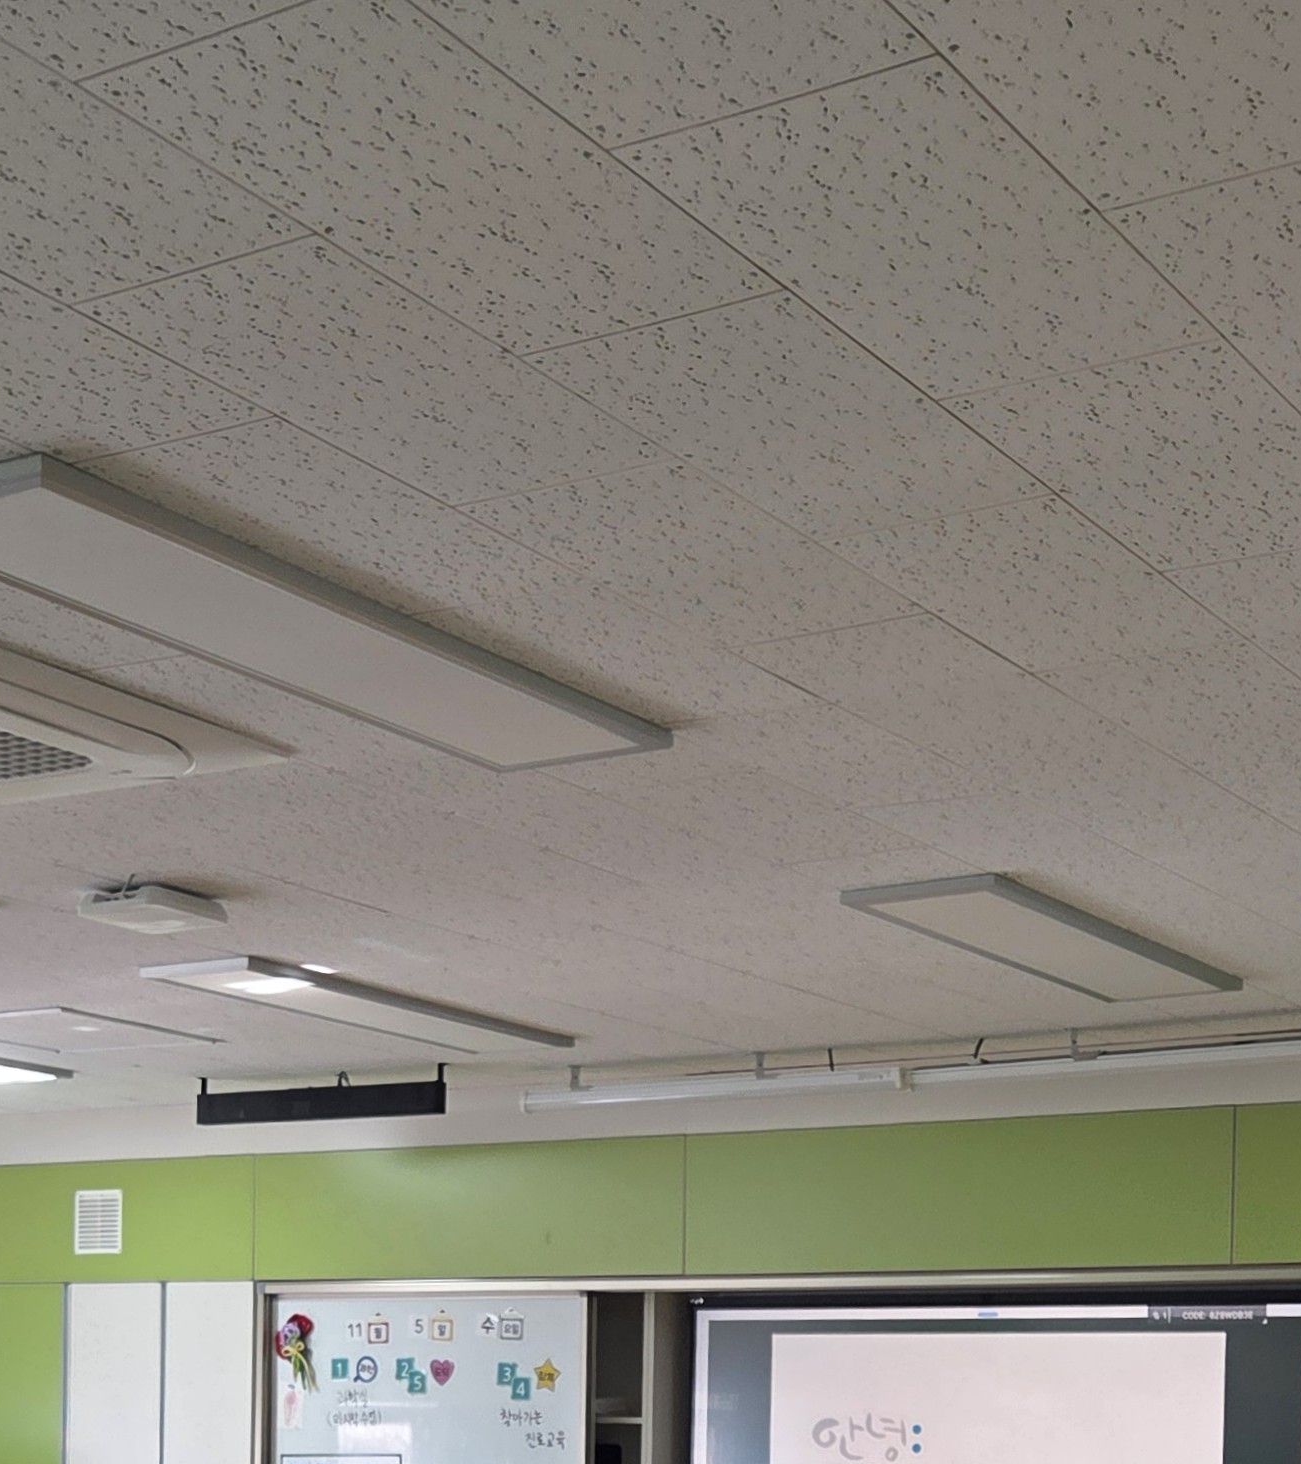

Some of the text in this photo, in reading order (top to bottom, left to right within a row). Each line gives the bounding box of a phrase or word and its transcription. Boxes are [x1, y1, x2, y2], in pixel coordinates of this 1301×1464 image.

[347, 1322, 362, 1338] 11
[414, 1318, 424, 1334] 5
[480, 1316, 496, 1334] 수
[401, 1362, 409, 1377] 2
[503, 1367, 511, 1382] 3
[413, 1375, 422, 1390] 5
[515, 1382, 525, 1397] 4
[811, 1412, 922, 1462] 안녕:
